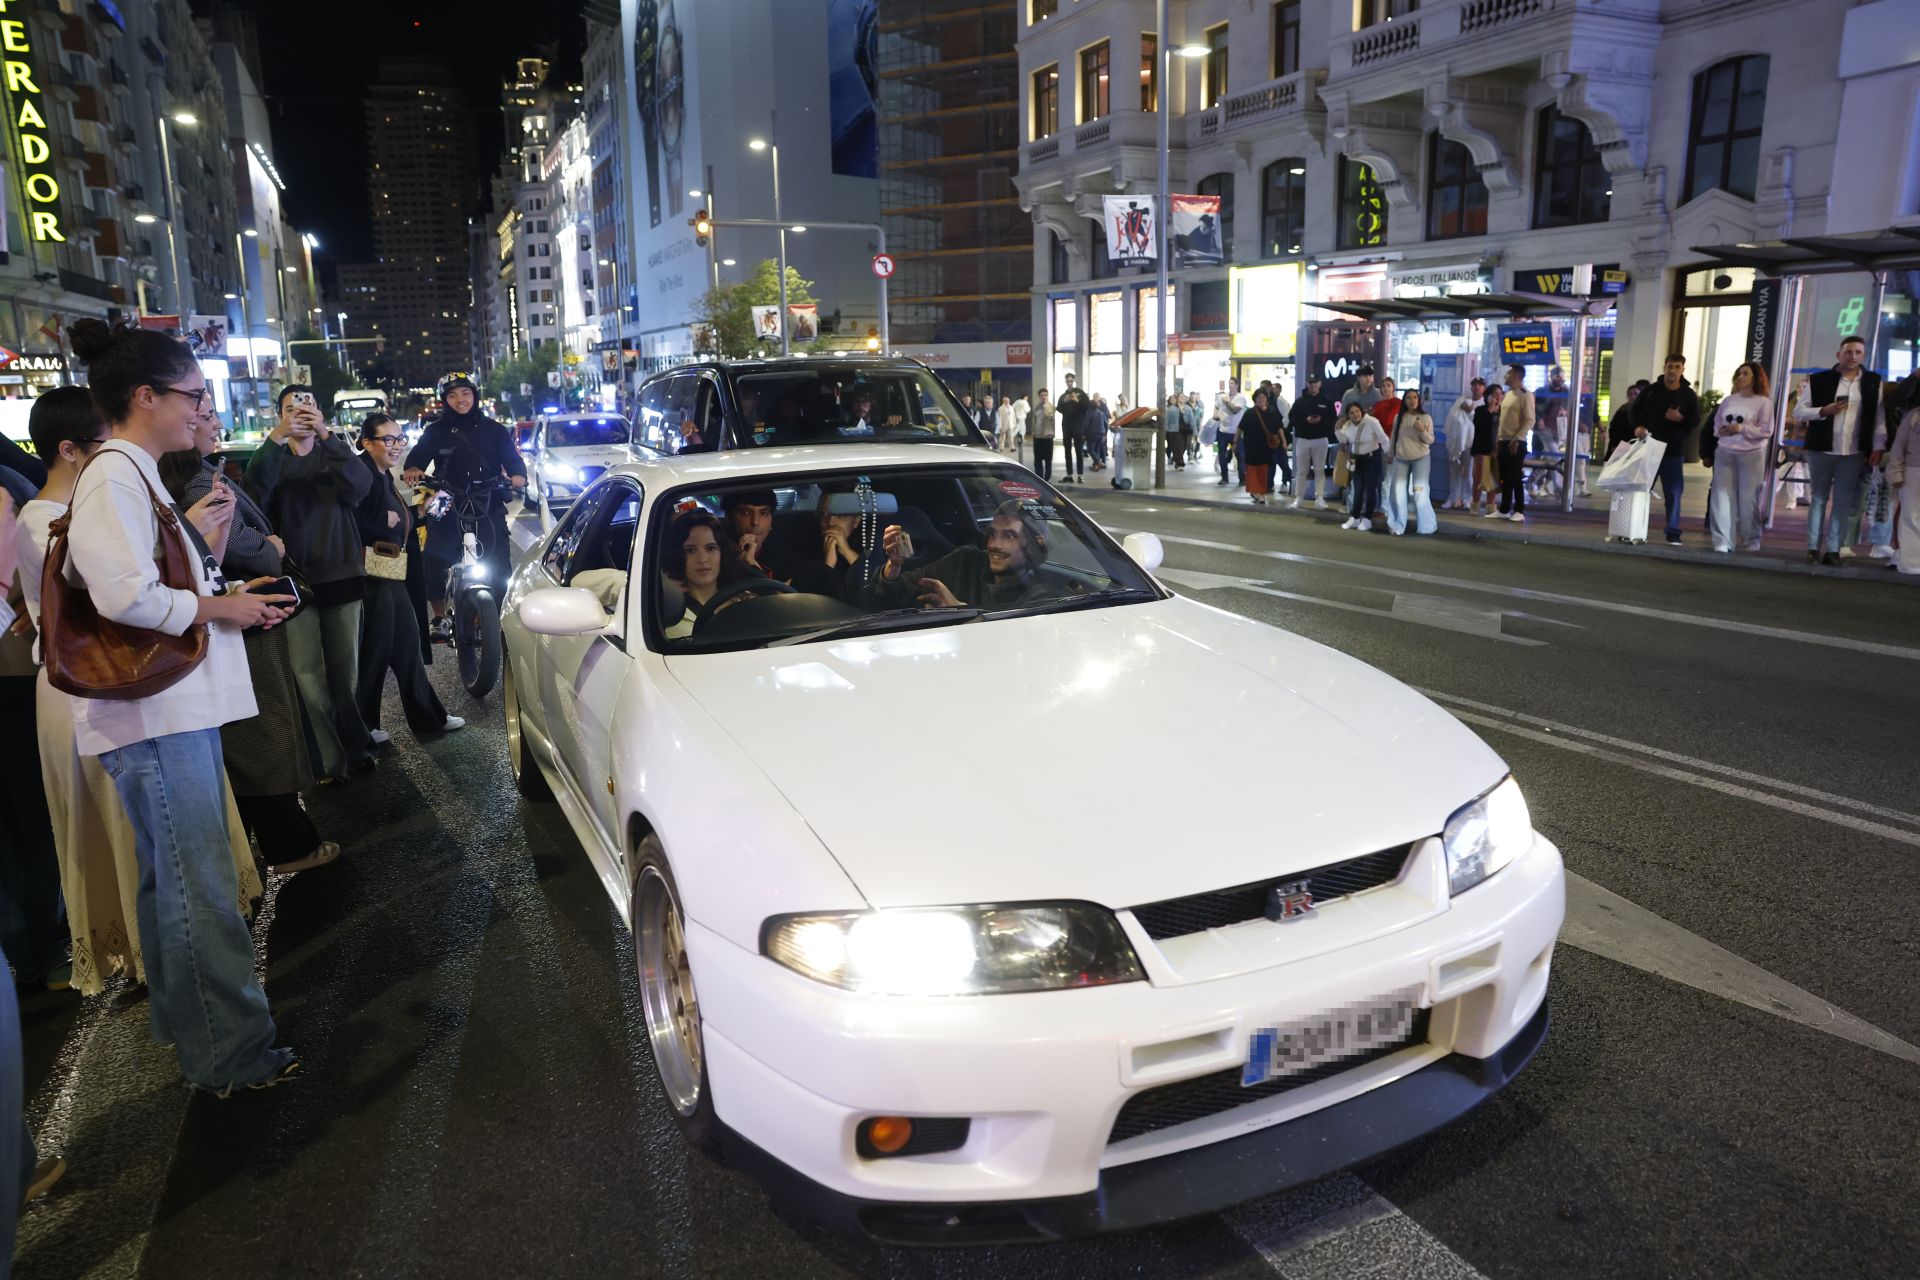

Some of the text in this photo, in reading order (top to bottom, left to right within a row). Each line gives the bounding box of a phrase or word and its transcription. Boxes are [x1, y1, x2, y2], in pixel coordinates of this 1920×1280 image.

[0, 0, 66, 242] ERADOR
[1430, 271, 1477, 283] ITALIANOS
[1758, 286, 1770, 307] VIA
[1755, 308, 1767, 340] GRAN
